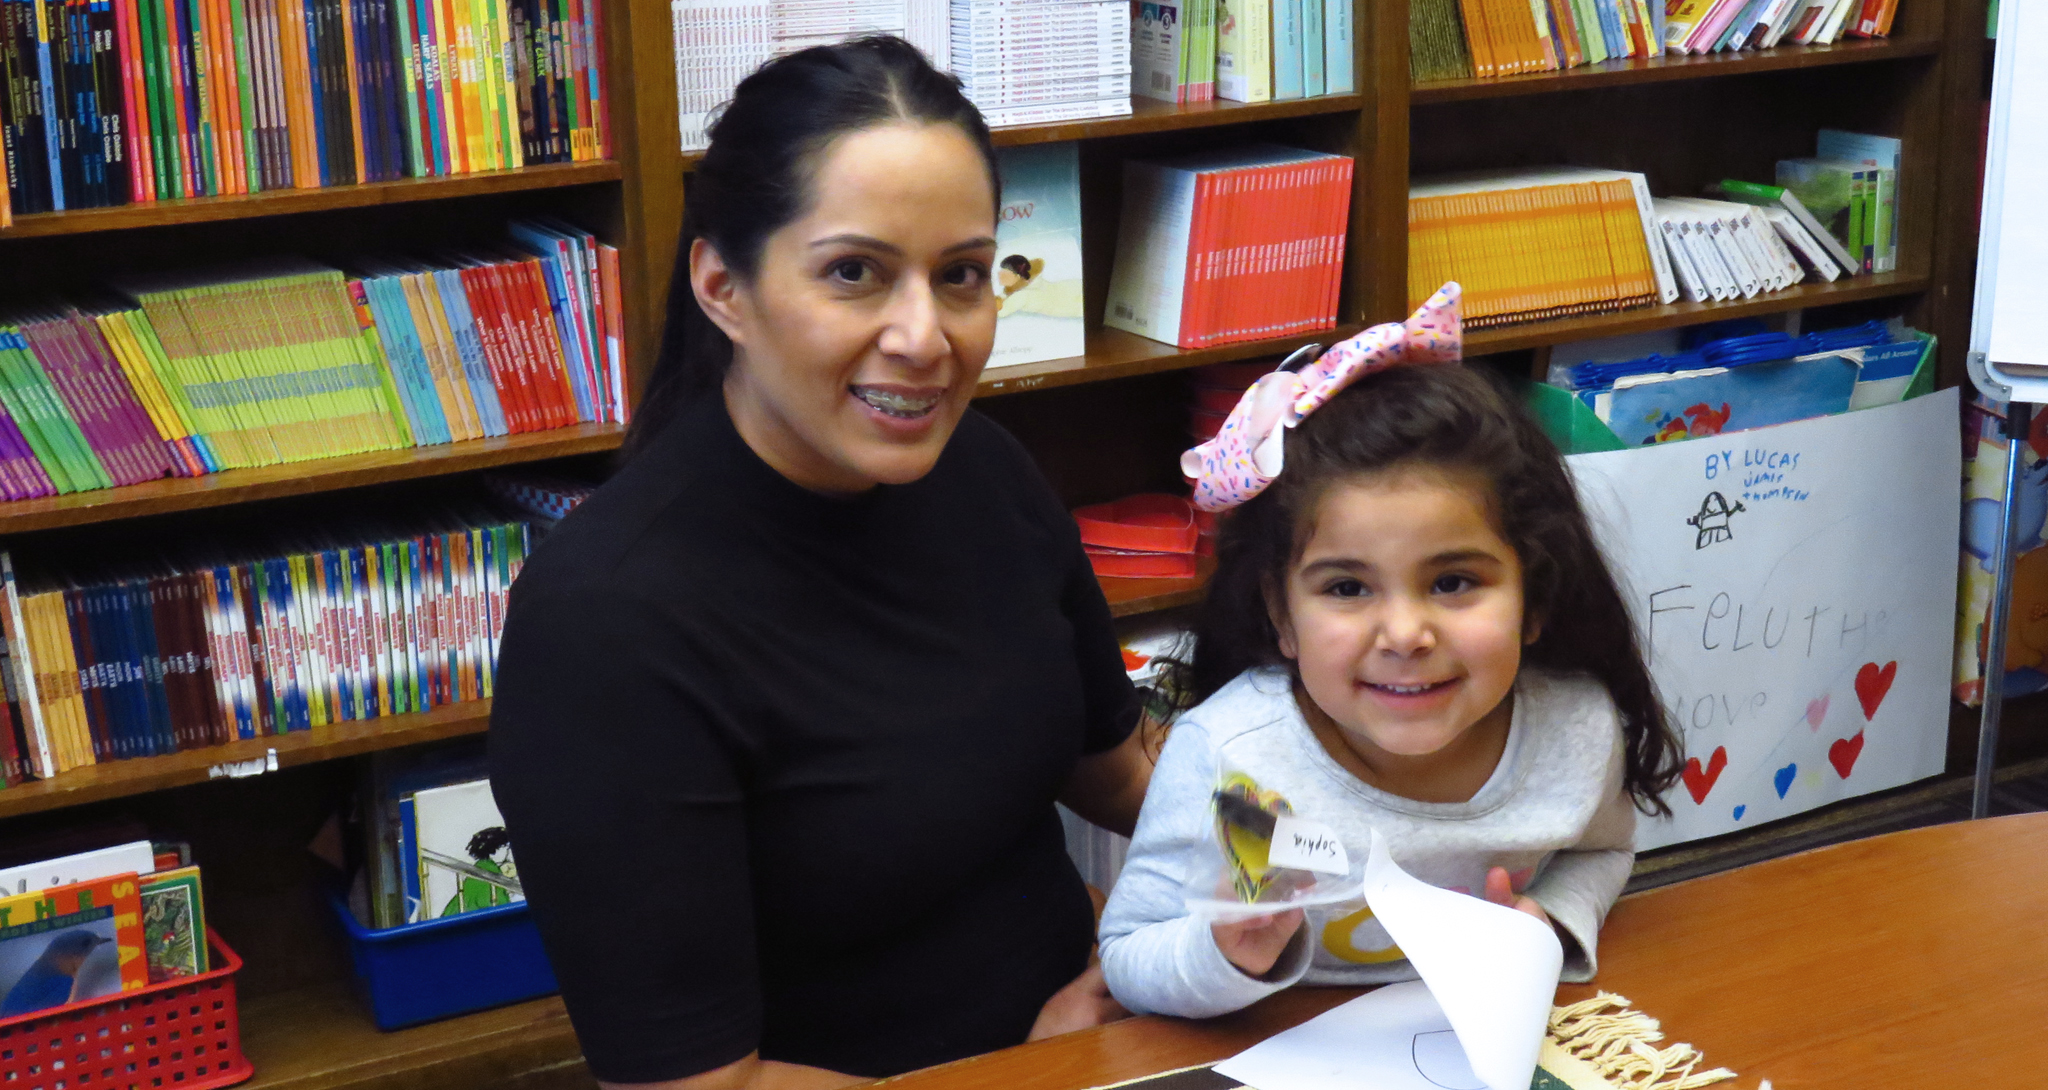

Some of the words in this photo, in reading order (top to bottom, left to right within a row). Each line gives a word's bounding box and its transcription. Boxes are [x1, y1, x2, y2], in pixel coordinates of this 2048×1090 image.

[1705, 450, 1732, 480] BY
[1744, 449, 1800, 470] LUCAS
[1293, 833, 1336, 857] Sophia
